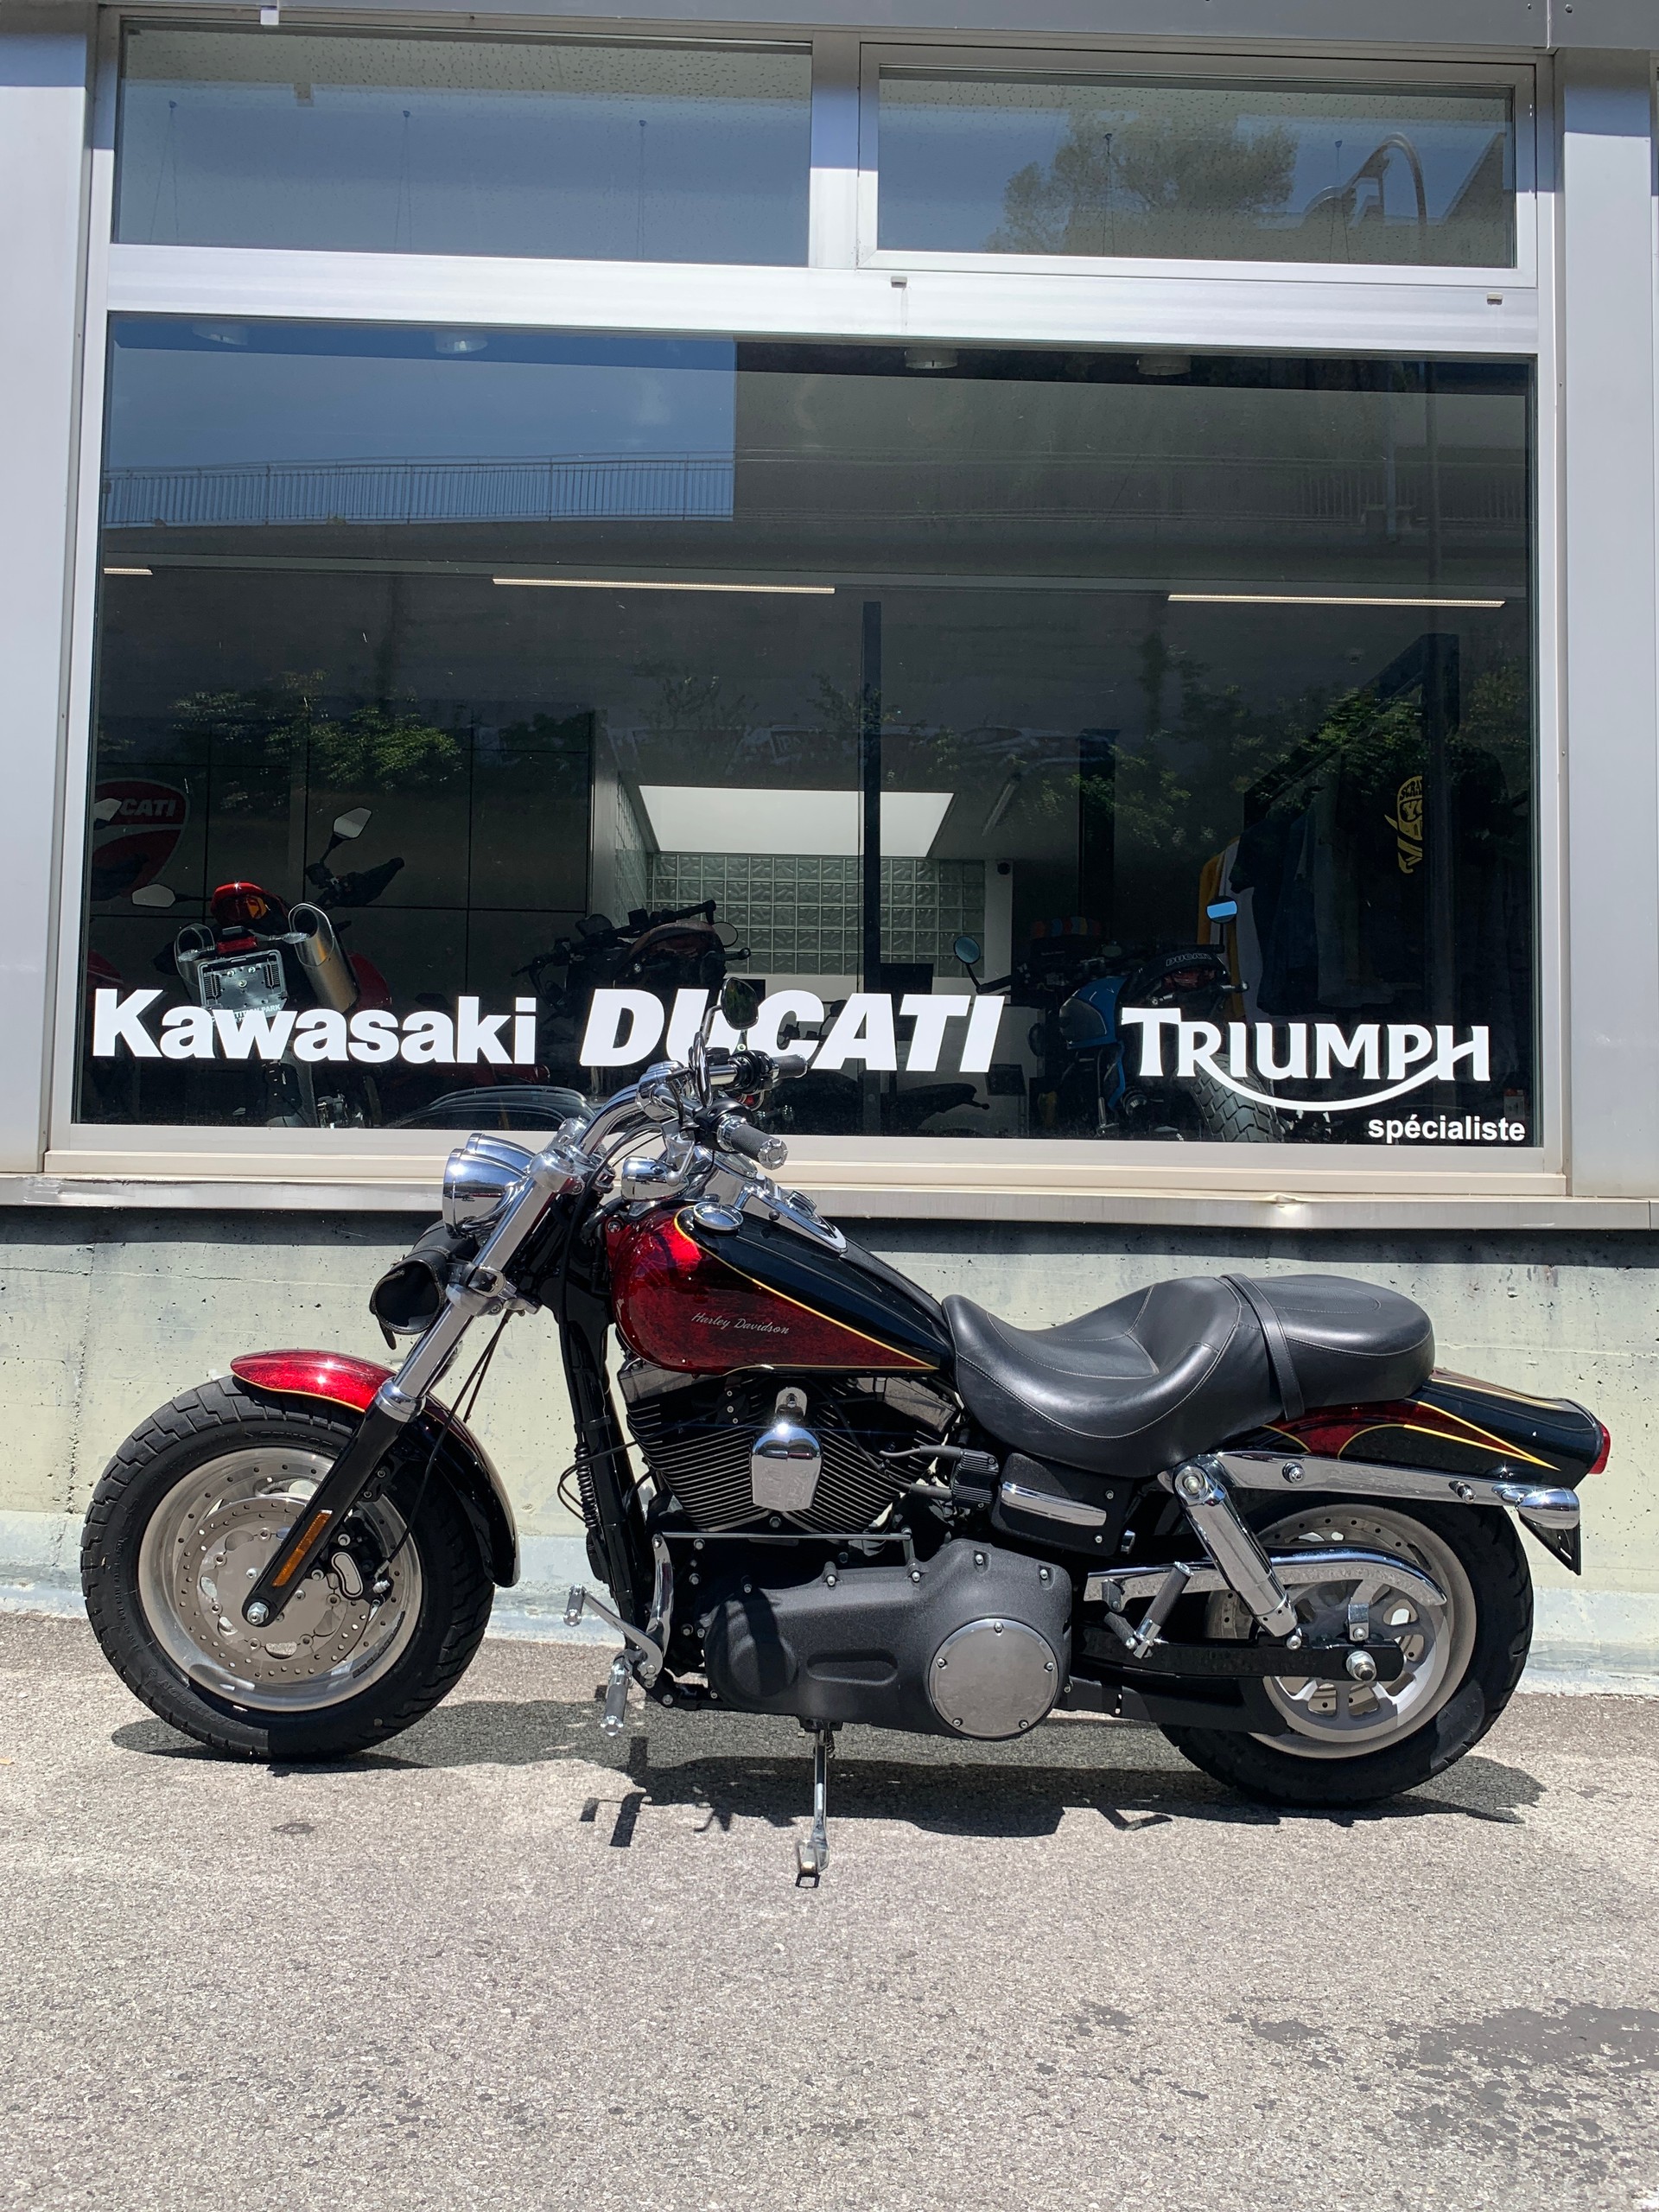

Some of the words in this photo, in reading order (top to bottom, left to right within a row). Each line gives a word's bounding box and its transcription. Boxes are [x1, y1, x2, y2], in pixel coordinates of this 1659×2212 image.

[121, 798, 177, 817] CATI
[92, 988, 537, 1065] Kawasaki
[579, 988, 1005, 1073] DUCATI
[1121, 1007, 1491, 1111] TRIUMPH
[1368, 1116, 1525, 1143] spécialiste
[690, 1312, 731, 1330] Harley
[734, 1318, 790, 1335] Davidson
